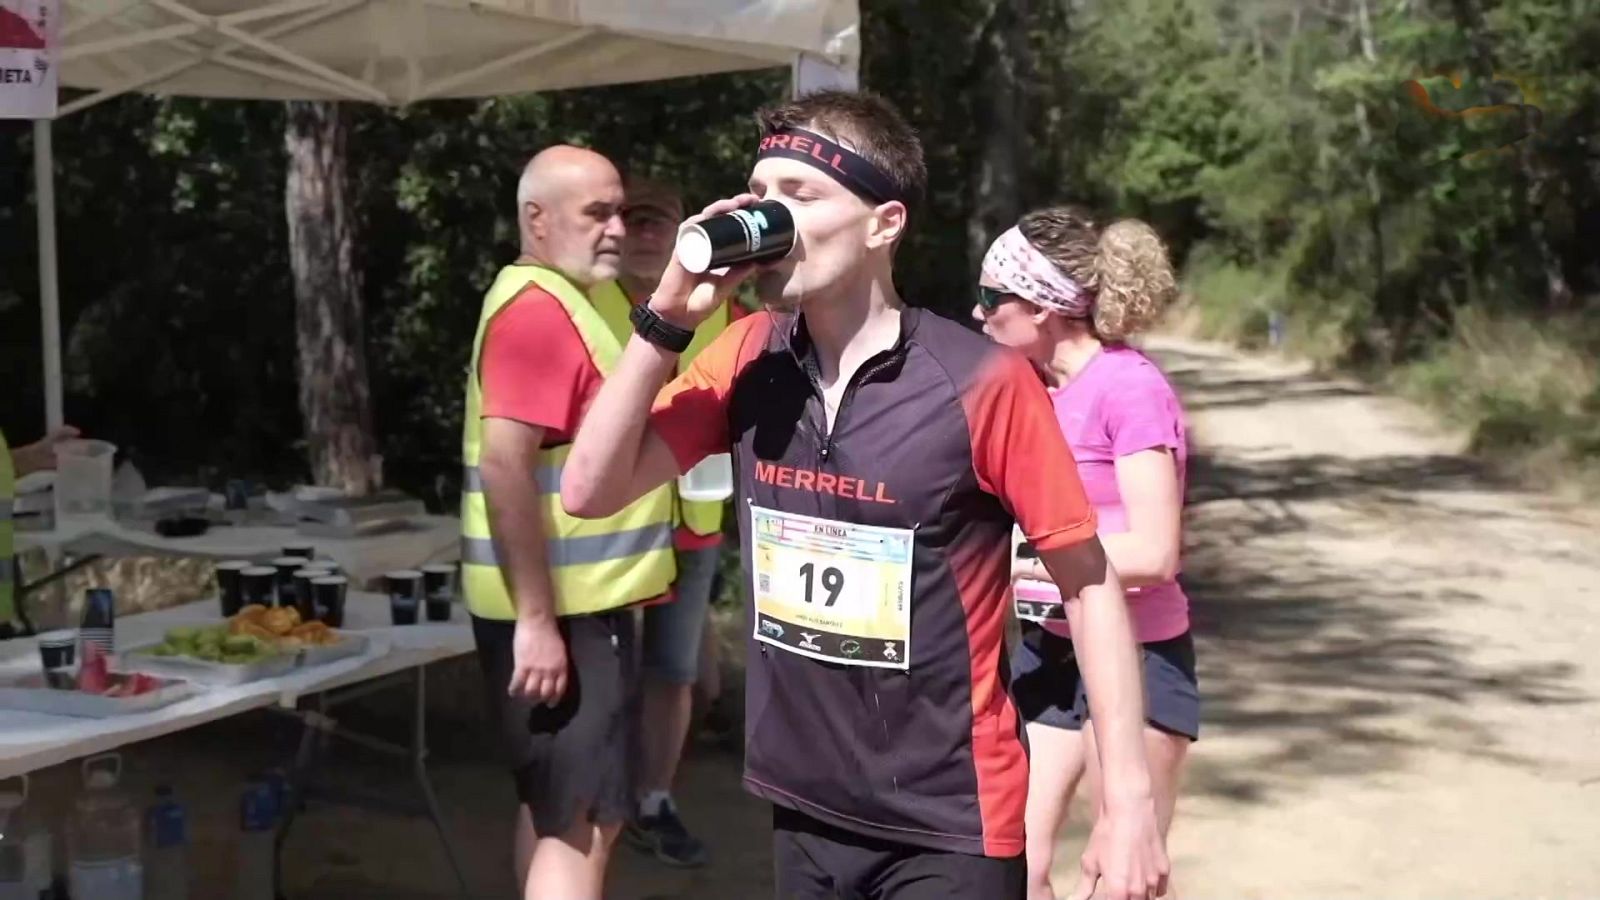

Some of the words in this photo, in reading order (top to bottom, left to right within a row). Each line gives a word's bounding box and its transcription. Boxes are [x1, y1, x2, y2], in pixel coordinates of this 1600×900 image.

[0, 68, 32, 83] ETA
[755, 461, 896, 503] MERRELL
[800, 562, 844, 607] 19
